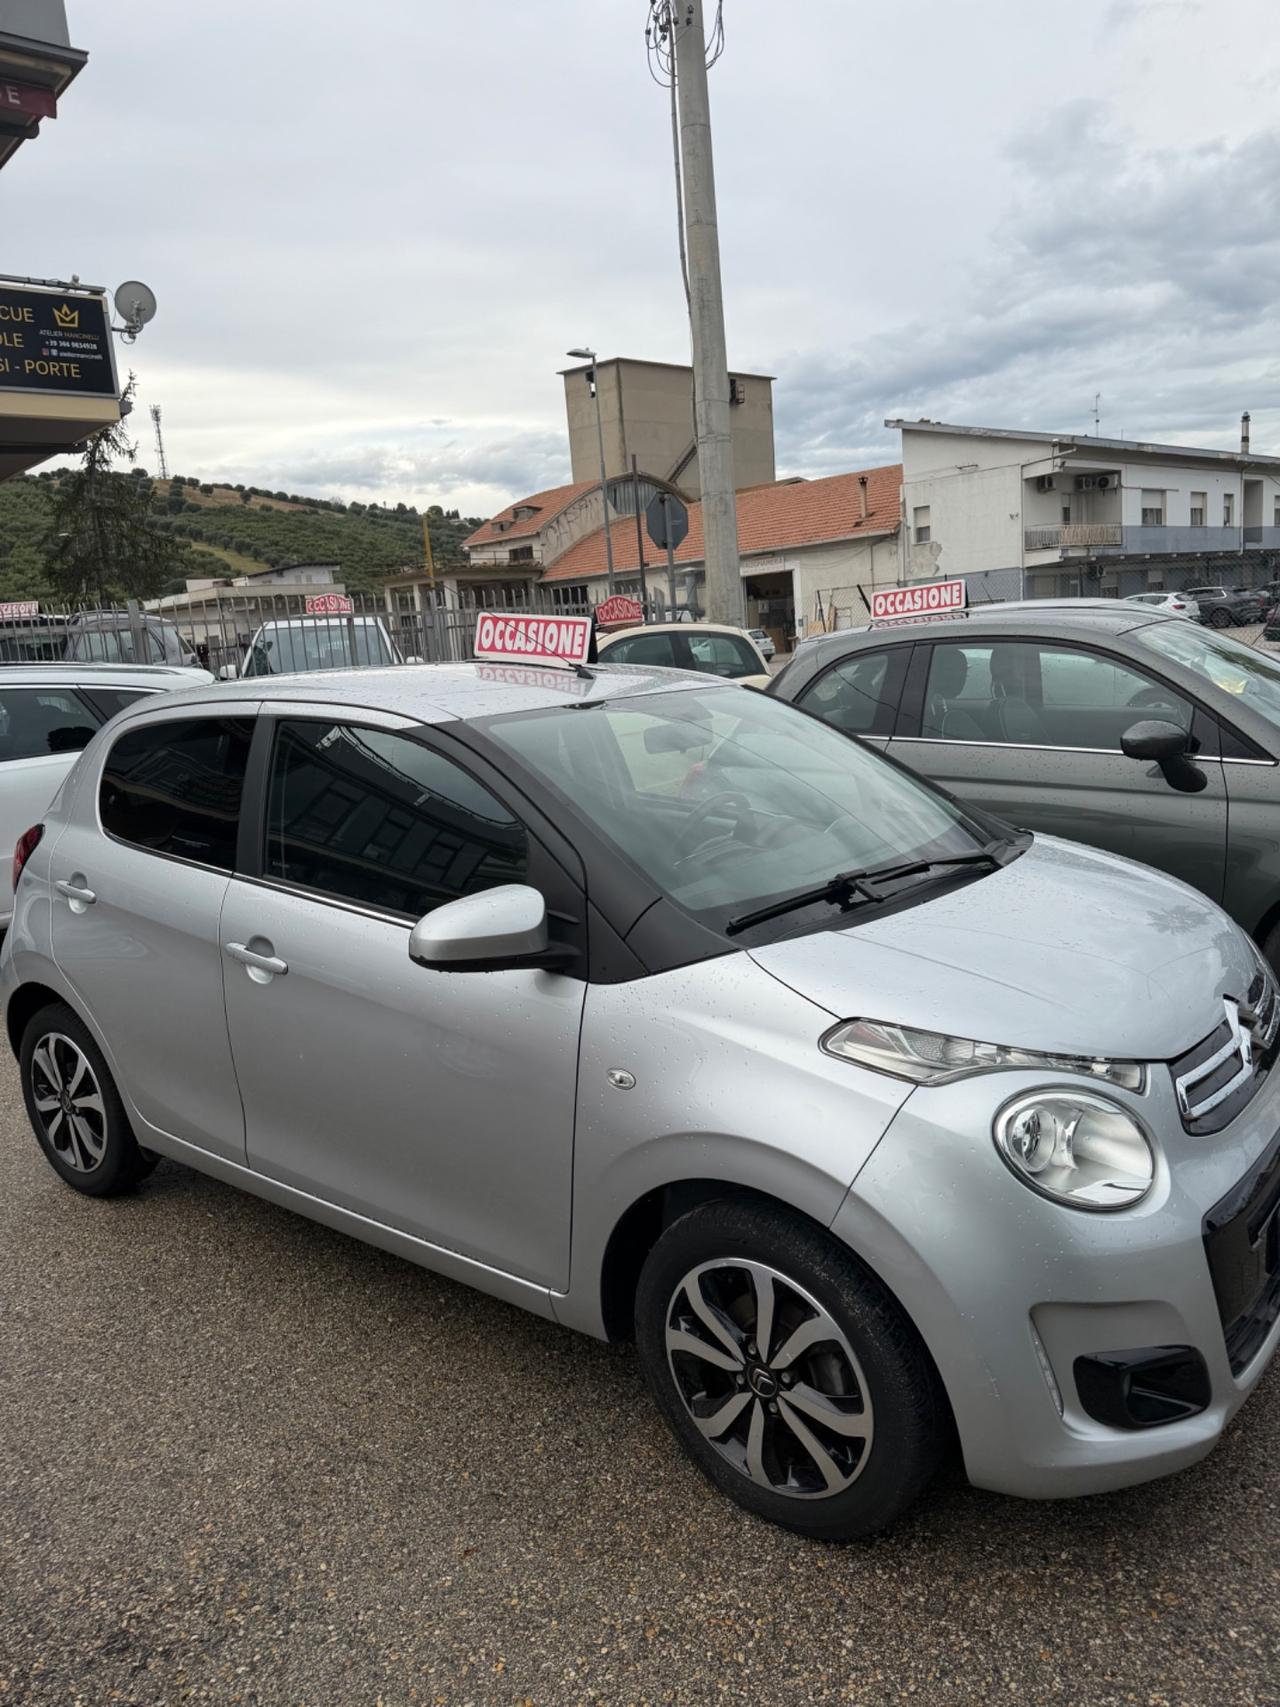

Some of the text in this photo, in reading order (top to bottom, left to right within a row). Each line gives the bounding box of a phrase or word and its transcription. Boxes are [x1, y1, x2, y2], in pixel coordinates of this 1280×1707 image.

[24, 360, 81, 378] PORTE
[875, 584, 961, 615] OCCASIONE
[481, 618, 584, 656] OCCASIONE
